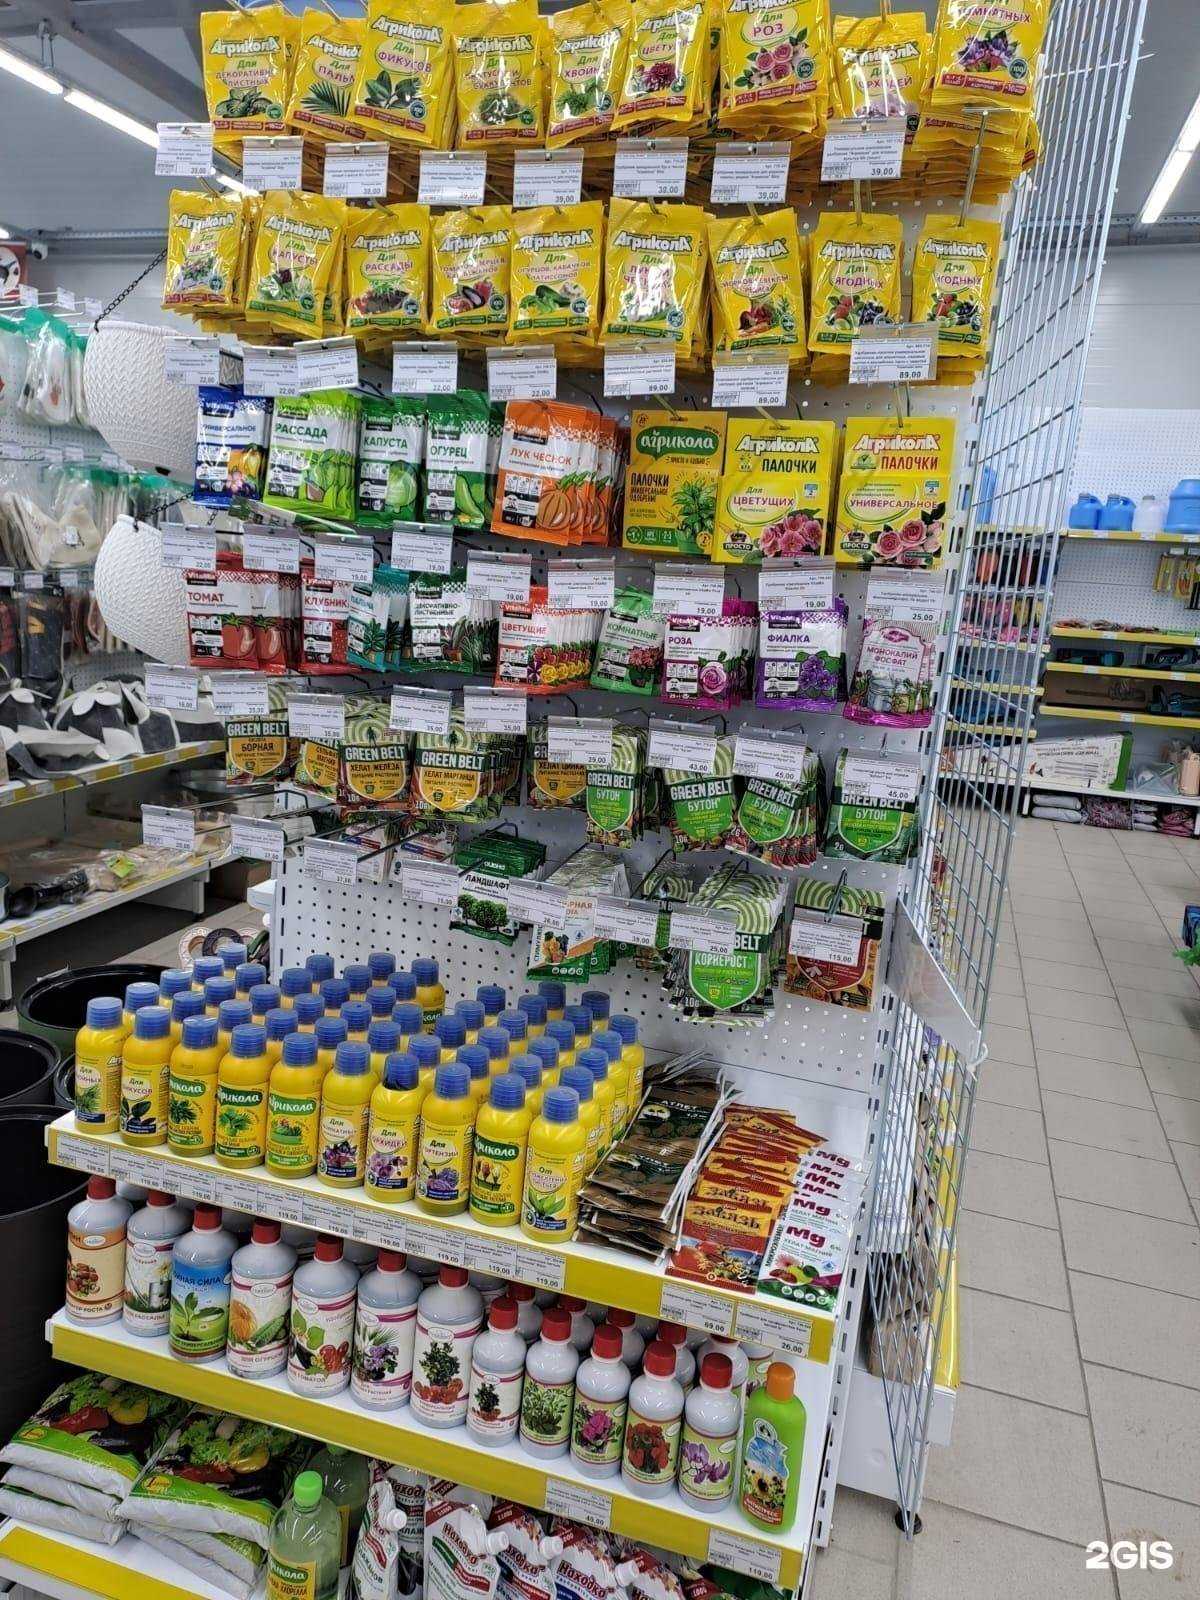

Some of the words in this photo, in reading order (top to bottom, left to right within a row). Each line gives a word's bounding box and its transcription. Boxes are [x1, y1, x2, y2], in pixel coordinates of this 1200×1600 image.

[760, 13, 783, 23] Для
[753, 25, 783, 37] РОЗ
[236, 60, 257, 69] Для
[329, 60, 350, 71] Для
[378, 52, 431, 72] ФИКУСОВ
[871, 168, 893, 177] 39,00
[377, 252, 396, 261] Для
[544, 254, 565, 263] Для
[365, 261, 412, 271] РАССАДЫ
[746, 266, 763, 275] Для
[845, 265, 868, 274] Для
[944, 263, 965, 272] Для
[835, 276, 883, 289] ЯГОДНЫХ
[275, 423, 328, 438] РАССАДА
[363, 436, 408, 449] КАПУСТА
[641, 429, 715, 452] агрикола
[430, 445, 467, 459] ОГУРЕЦ
[510, 448, 529, 459] ЛУК
[533, 451, 572, 466] ЧЕСНОК
[762, 459, 817, 473] ПАЛОЧКИ
[881, 457, 938, 470] ПАЛОЧКИ
[632, 473, 669, 486] ПАЛОЧКИ
[746, 486, 762, 495] Для
[733, 496, 794, 507] ЦВЕТУЩИХ
[850, 499, 938, 509] УНИВЕРСАЛЬНОЕ
[188, 592, 224, 602] ТОМАТ
[501, 623, 547, 635] ЦВЕТУЩИЕ
[607, 623, 658, 641] КОМНАТНЫЕ
[668, 637, 692, 645] РОЗА
[768, 634, 810, 644] ФИАЛКА
[867, 646, 918, 659] МОНОКАЛИЙ
[875, 656, 906, 666] ФОСФАТ
[227, 722, 259, 736] GREEN
[262, 721, 287, 736] BELT
[241, 743, 273, 752] БОРНАЯ
[345, 747, 378, 762] GREEN
[381, 746, 405, 760] BELT
[422, 751, 456, 766] GREEN
[458, 754, 485, 769] BELT
[588, 772, 611, 785] GREEN
[613, 774, 634, 788] BELT
[596, 790, 620, 801] БУТОН
[670, 783, 705, 800] GREEN
[707, 779, 732, 796] BELT
[747, 779, 776, 800] GREEN
[775, 786, 797, 805] BELT
[888, 791, 908, 799] 45,00
[688, 798, 719, 812] БУТОН
[752, 797, 781, 815] БУТОН
[855, 808, 887, 820] БУТОН
[465, 874, 510, 890] ЛАНДШАФТ
[735, 935, 761, 949] BELT
[695, 954, 748, 968] КОРНЕРОСТ
[129, 1078, 144, 1086] Для
[329, 1118, 344, 1127] Для
[430, 1140, 446, 1148] Для
[793, 1198, 831, 1216] Mg
[786, 1226, 826, 1247] Mg
